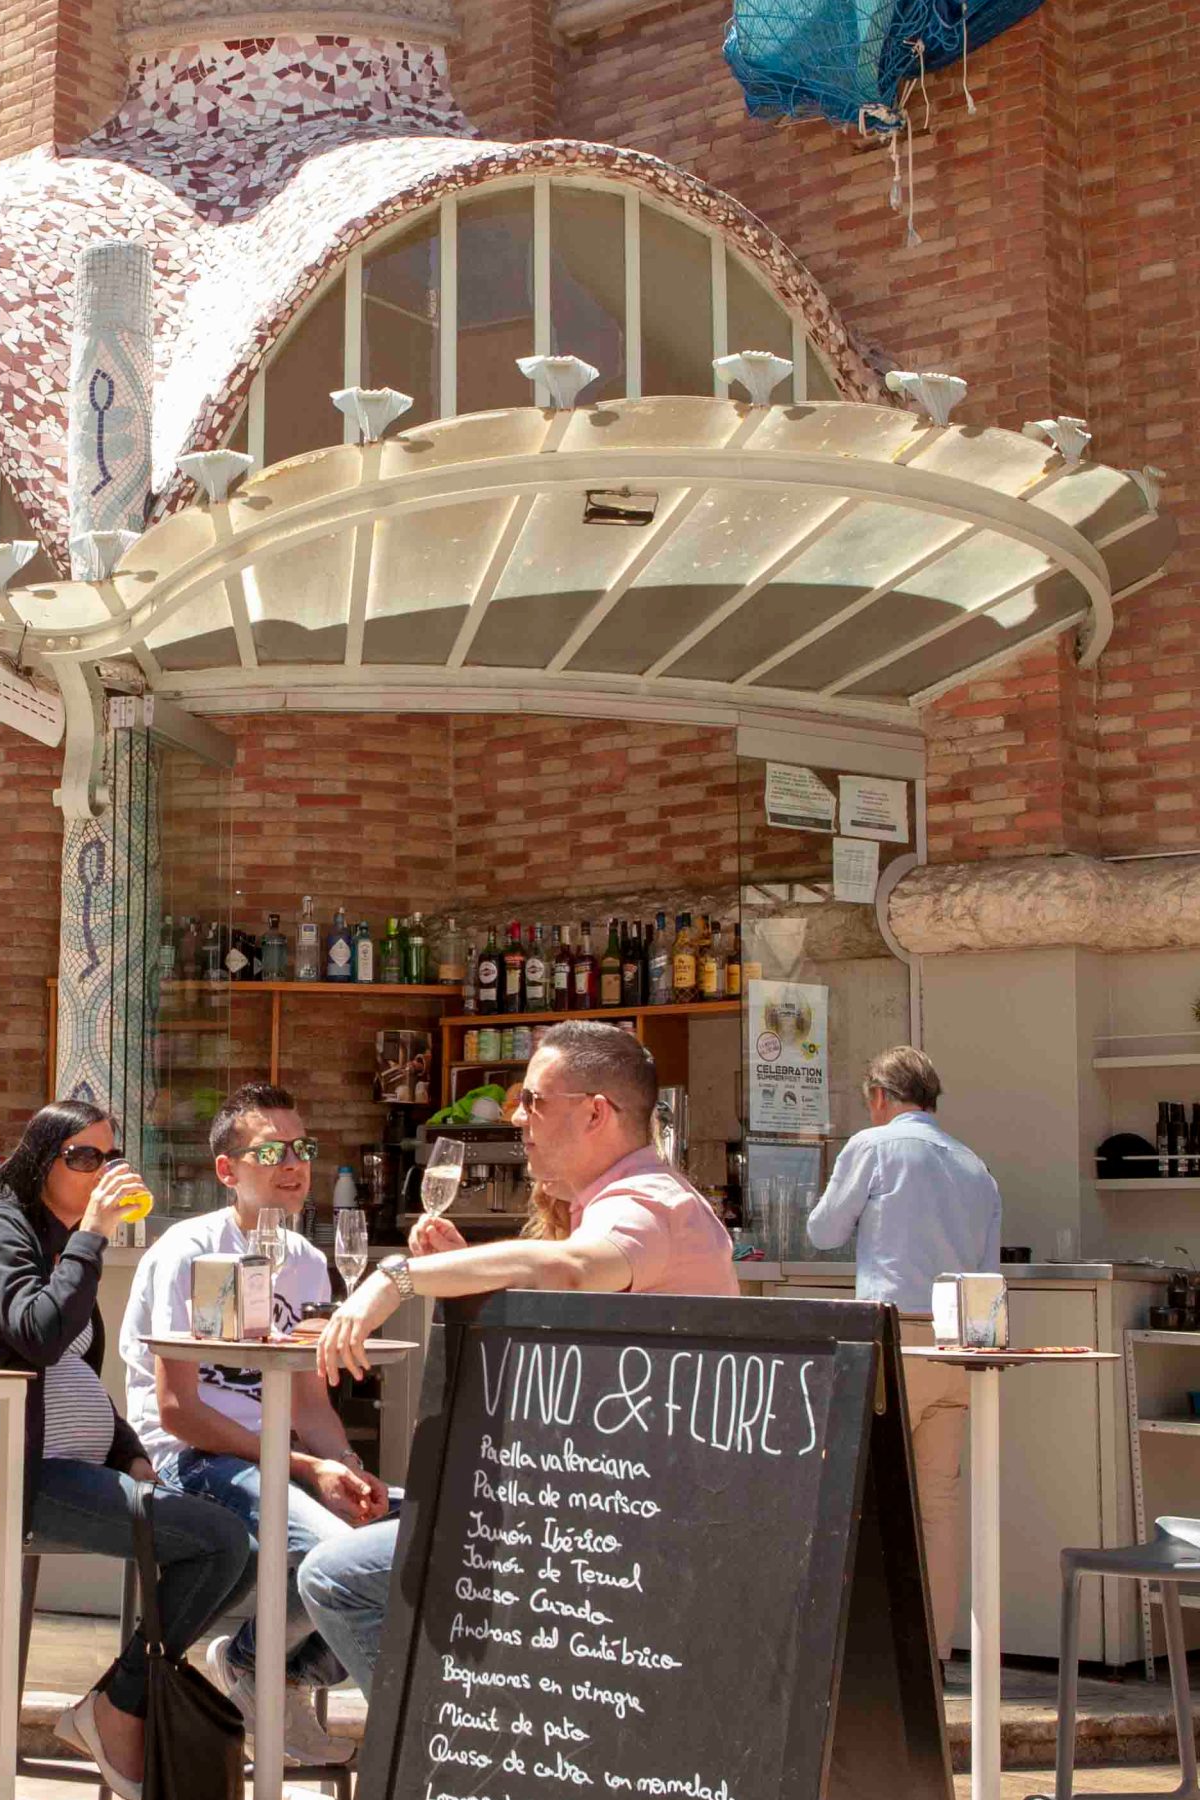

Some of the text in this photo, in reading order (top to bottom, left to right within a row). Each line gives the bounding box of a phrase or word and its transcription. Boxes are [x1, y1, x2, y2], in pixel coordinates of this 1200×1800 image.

[757, 1064, 822, 1076] CELEBRATION
[480, 1337, 817, 1456] VINO & FLORES
[481, 1434, 651, 1480] Paella valenciana
[474, 1469, 662, 1518] Paella de marisco
[467, 1511, 623, 1553] Jamón Ibérico
[462, 1543, 644, 1593] Jamón de Teruel
[455, 1577, 614, 1625] Queso Curado
[450, 1613, 523, 1646] Anchoas
[531, 1626, 559, 1649] del
[441, 1654, 646, 1719] Boquerones en vinagre
[438, 1702, 501, 1732] Micuit
[510, 1712, 533, 1737] de
[428, 1733, 493, 1768] Queso
[502, 1749, 527, 1775] de
[604, 1771, 633, 1791] con
[636, 1773, 736, 1800] mermelad
